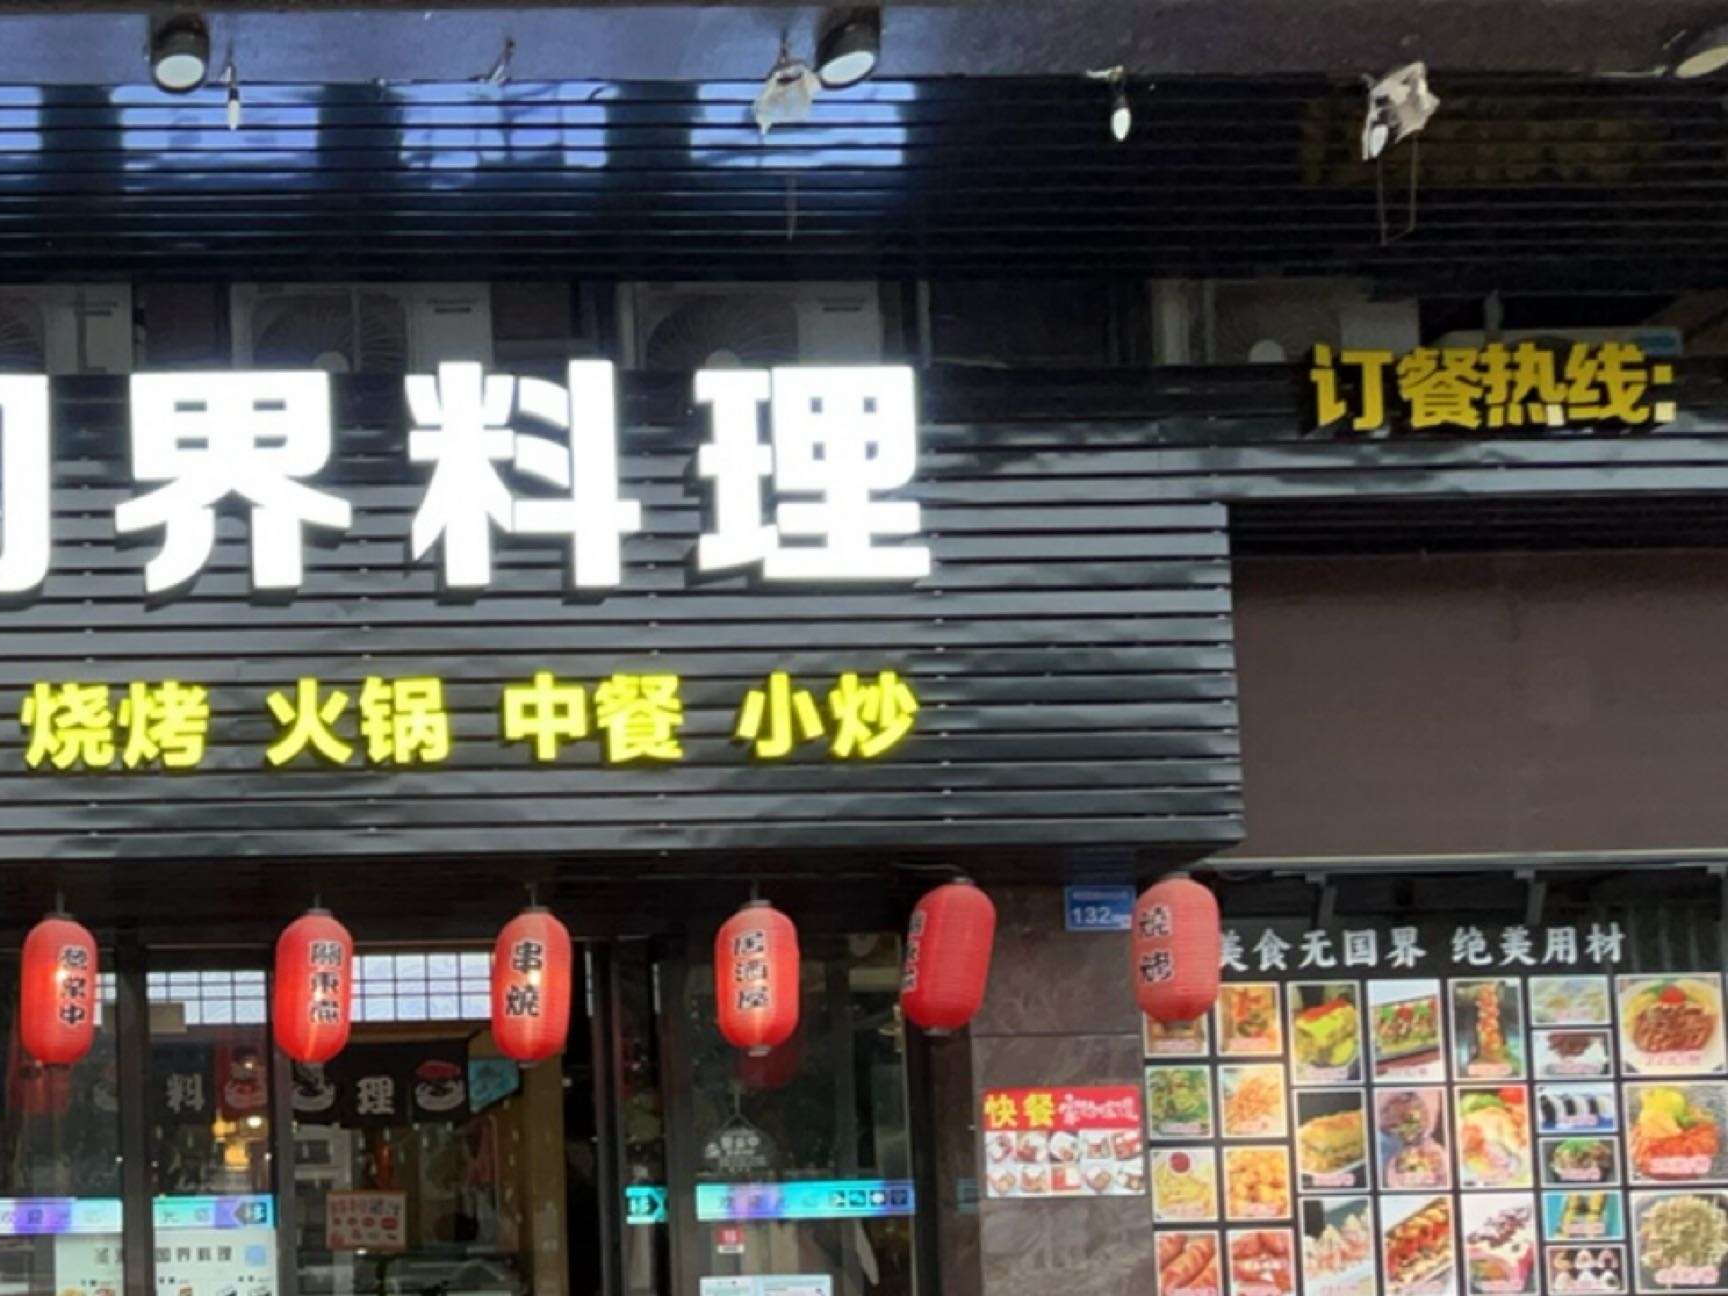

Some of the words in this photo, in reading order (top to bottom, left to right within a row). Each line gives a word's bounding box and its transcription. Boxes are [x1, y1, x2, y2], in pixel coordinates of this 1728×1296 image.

[20, 680, 210, 770] 烧烤
[265, 676, 451, 768] 火锅
[502, 672, 686, 764] 中餐
[735, 671, 920, 762] 小炒
[1451, 921, 1627, 968] 绝美用材
[732, 928, 771, 1012] 居酒屋
[358, 1077, 395, 1114] 理
[984, 1092, 1055, 1130] 快餐
